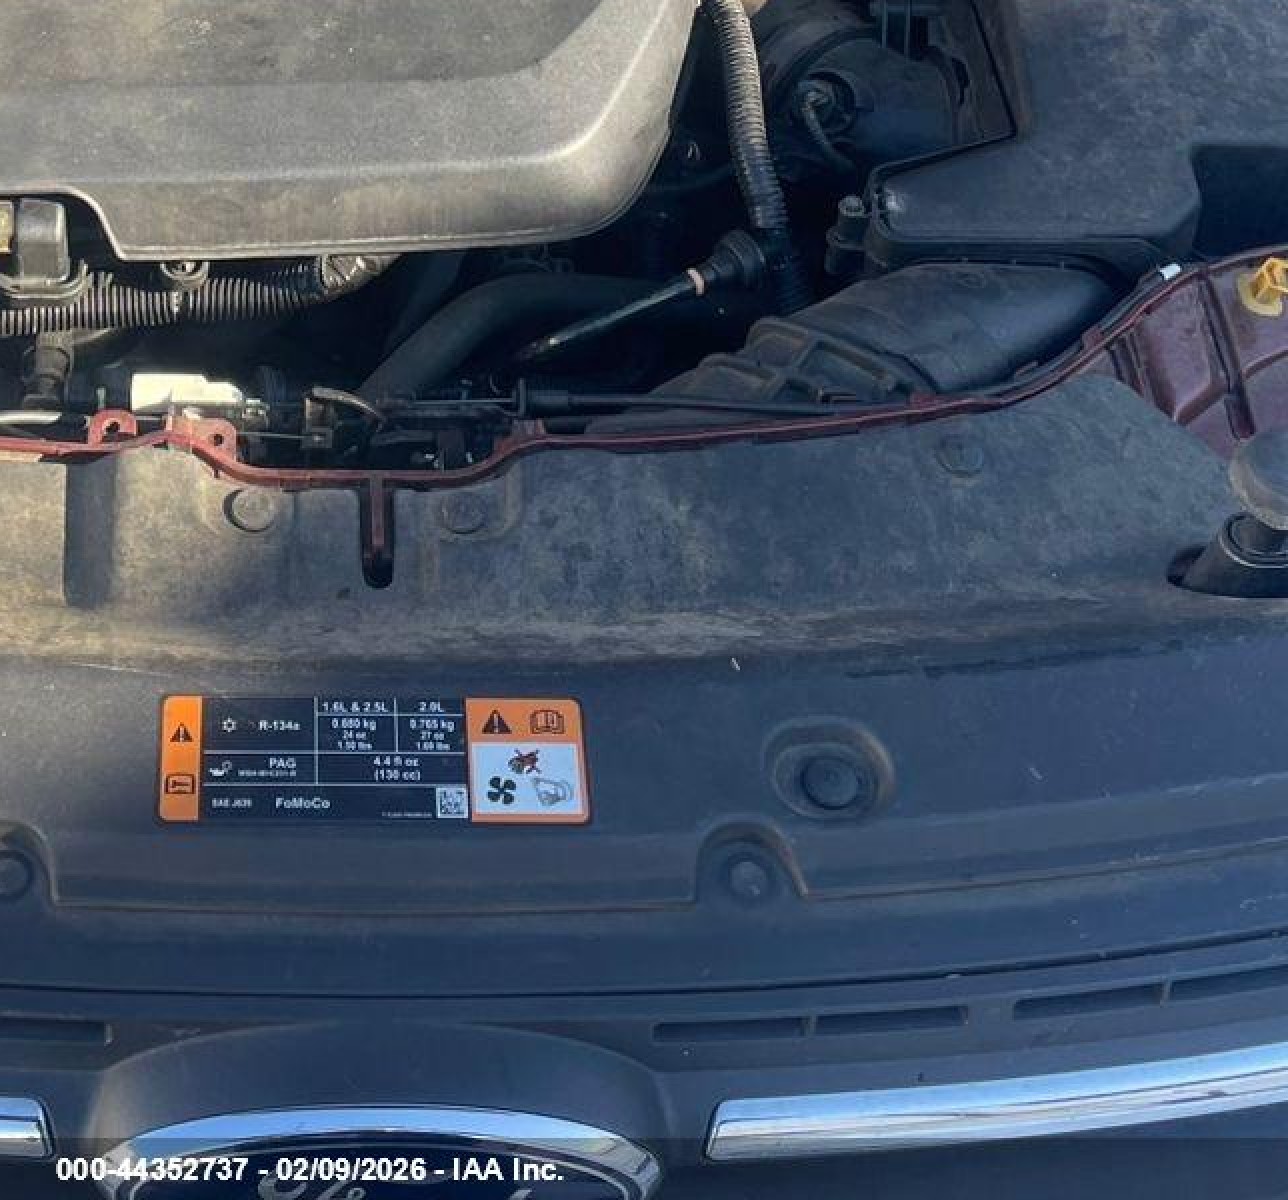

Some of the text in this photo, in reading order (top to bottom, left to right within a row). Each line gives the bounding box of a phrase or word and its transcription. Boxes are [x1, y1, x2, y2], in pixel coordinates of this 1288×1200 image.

[351, 701, 361, 713] &
[258, 719, 301, 731] R-134a
[363, 717, 377, 731] kg
[440, 718, 455, 733] kg
[268, 757, 297, 769] PAG
[275, 797, 331, 809] FoMoCo
